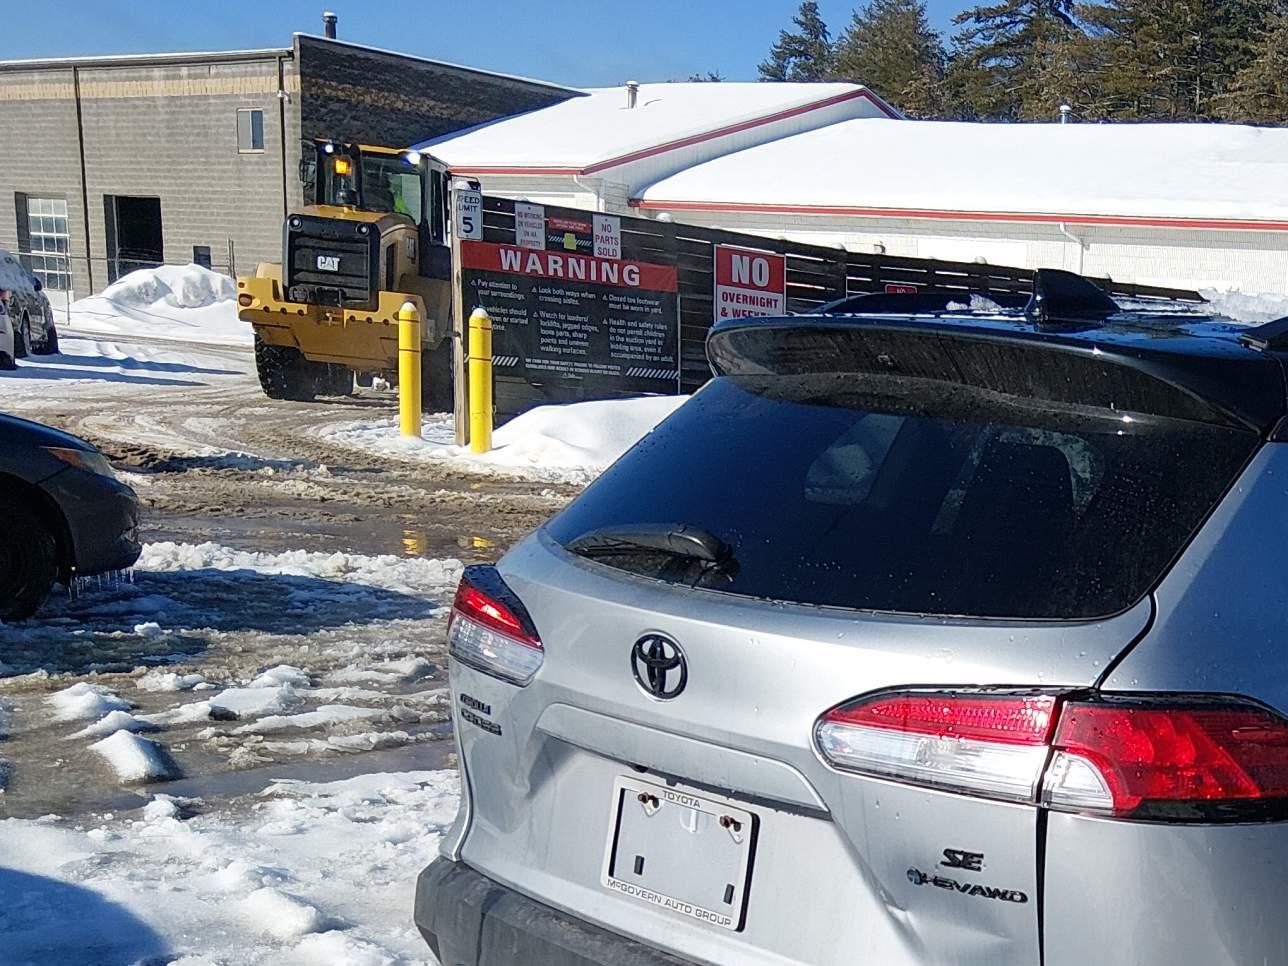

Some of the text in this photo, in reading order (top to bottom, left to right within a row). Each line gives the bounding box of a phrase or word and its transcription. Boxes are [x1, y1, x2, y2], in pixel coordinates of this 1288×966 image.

[458, 203, 479, 212] LIMIT
[463, 216, 474, 234] 5
[601, 224, 612, 233] NO
[595, 235, 619, 245] PARTS
[597, 247, 617, 258] SOLD
[317, 255, 340, 272] CAT
[499, 248, 641, 287] WARNING
[731, 254, 769, 287] NO
[721, 291, 779, 309] OVERNIGHT
[720, 307, 728, 318] &
[663, 790, 701, 808] TOYOTA
[940, 848, 985, 872] SE
[664, 898, 692, 914] AUTO
[695, 911, 731, 929] GROUP
